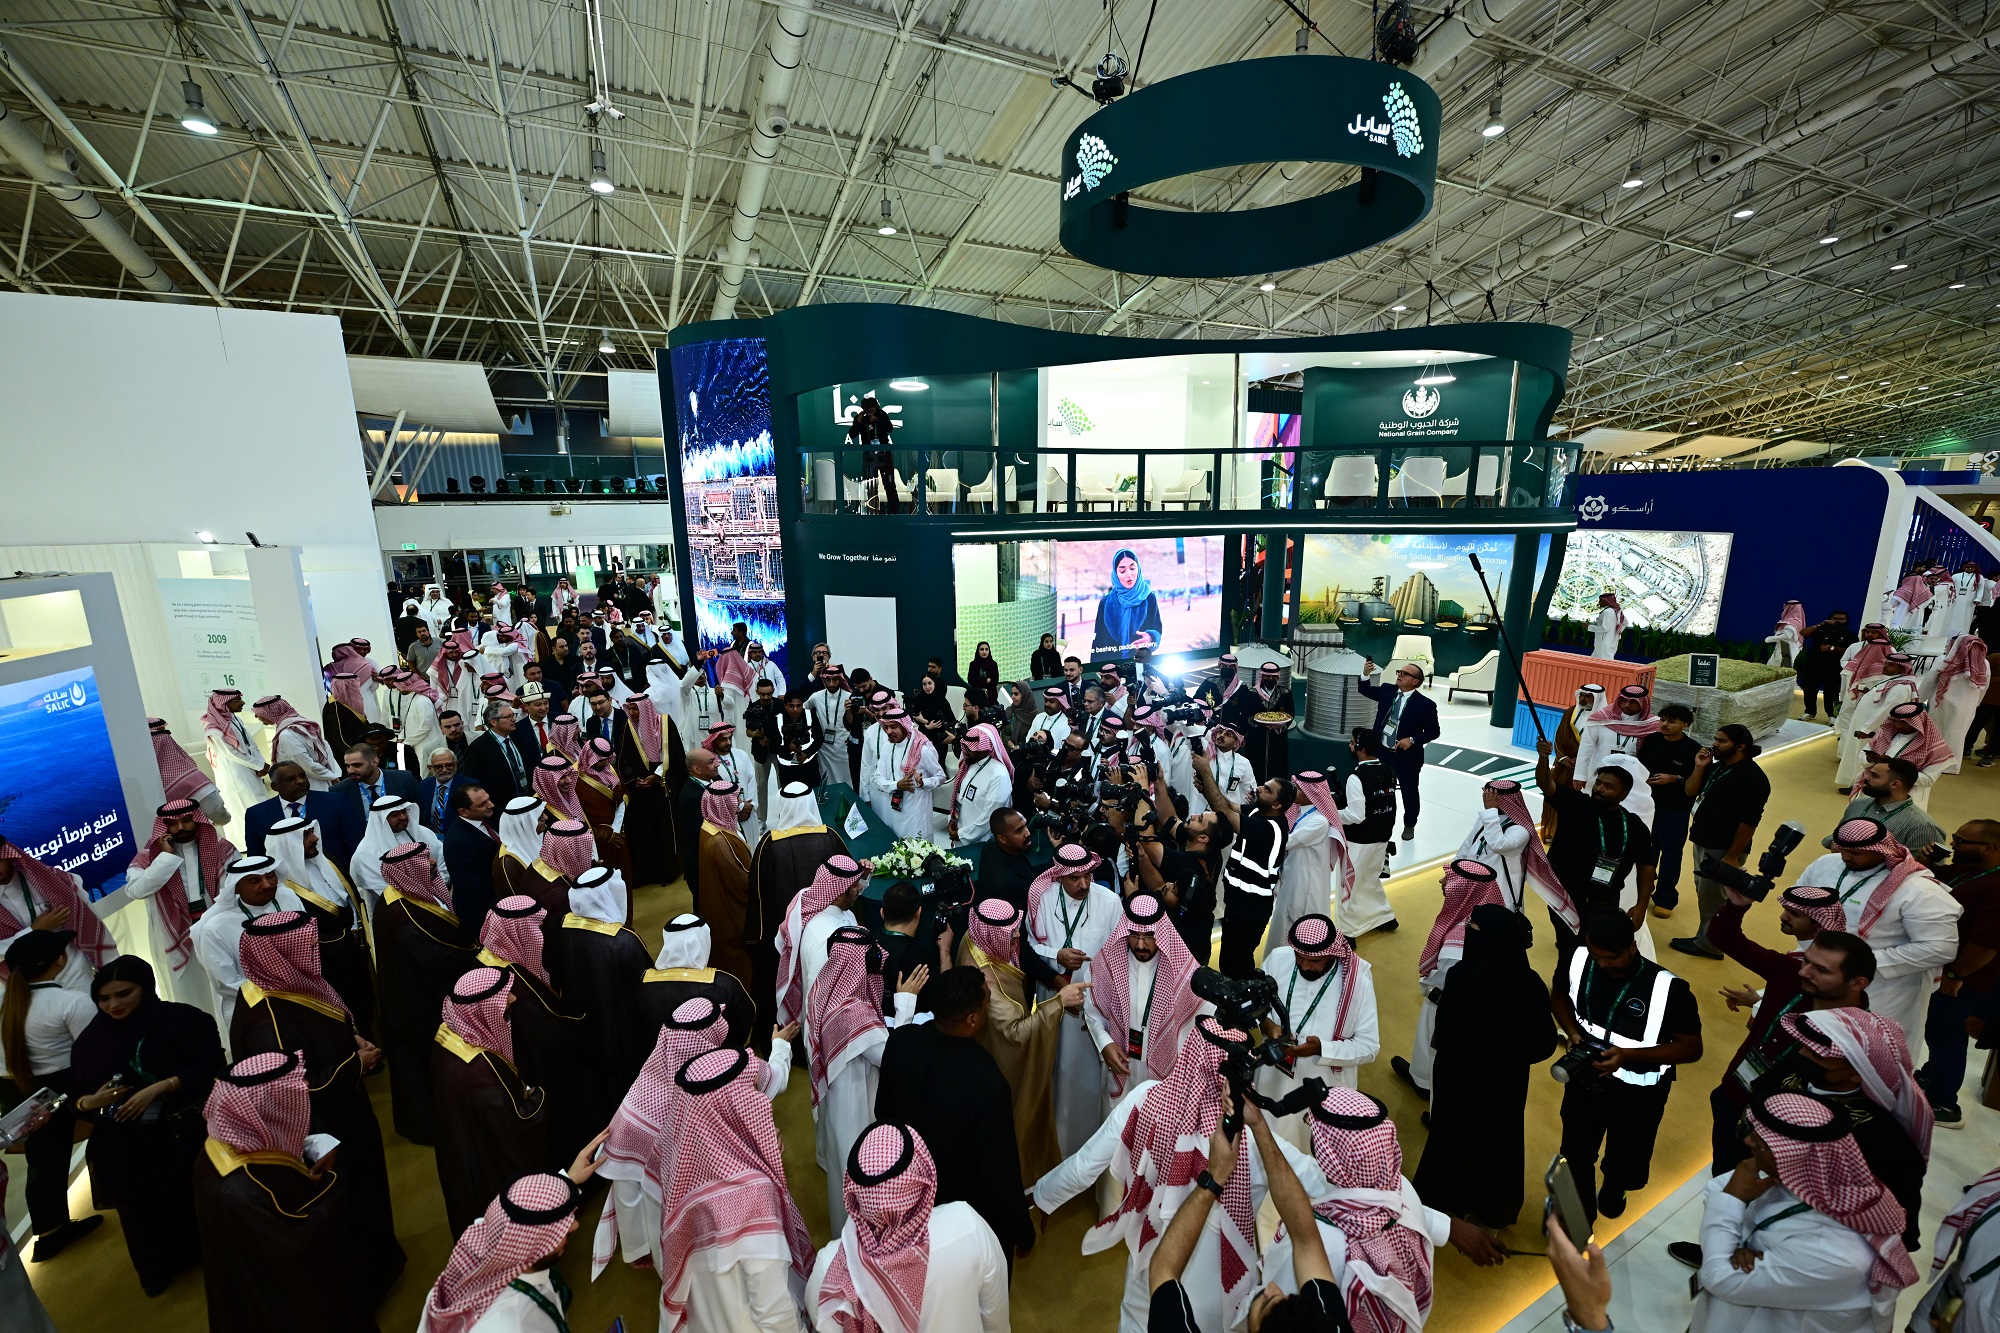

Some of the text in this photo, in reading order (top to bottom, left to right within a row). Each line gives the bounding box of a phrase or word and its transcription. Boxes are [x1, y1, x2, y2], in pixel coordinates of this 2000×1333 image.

[1348, 113, 1391, 136] سابل
[1369, 134, 1388, 145] SABIL
[1379, 417, 1460, 430] شركة الحبوب الوطنية
[842, 554, 870, 563] Together
[1377, 553, 1406, 561] Enabling
[1436, 553, 1469, 562] Sustainin
[207, 634, 227, 644] 2009
[223, 674, 235, 686] 16
[43, 691, 68, 703] سالك
[45, 699, 70, 714] SALIC
[93, 809, 118, 834] نصنع
[91, 831, 124, 861] تحقيق
